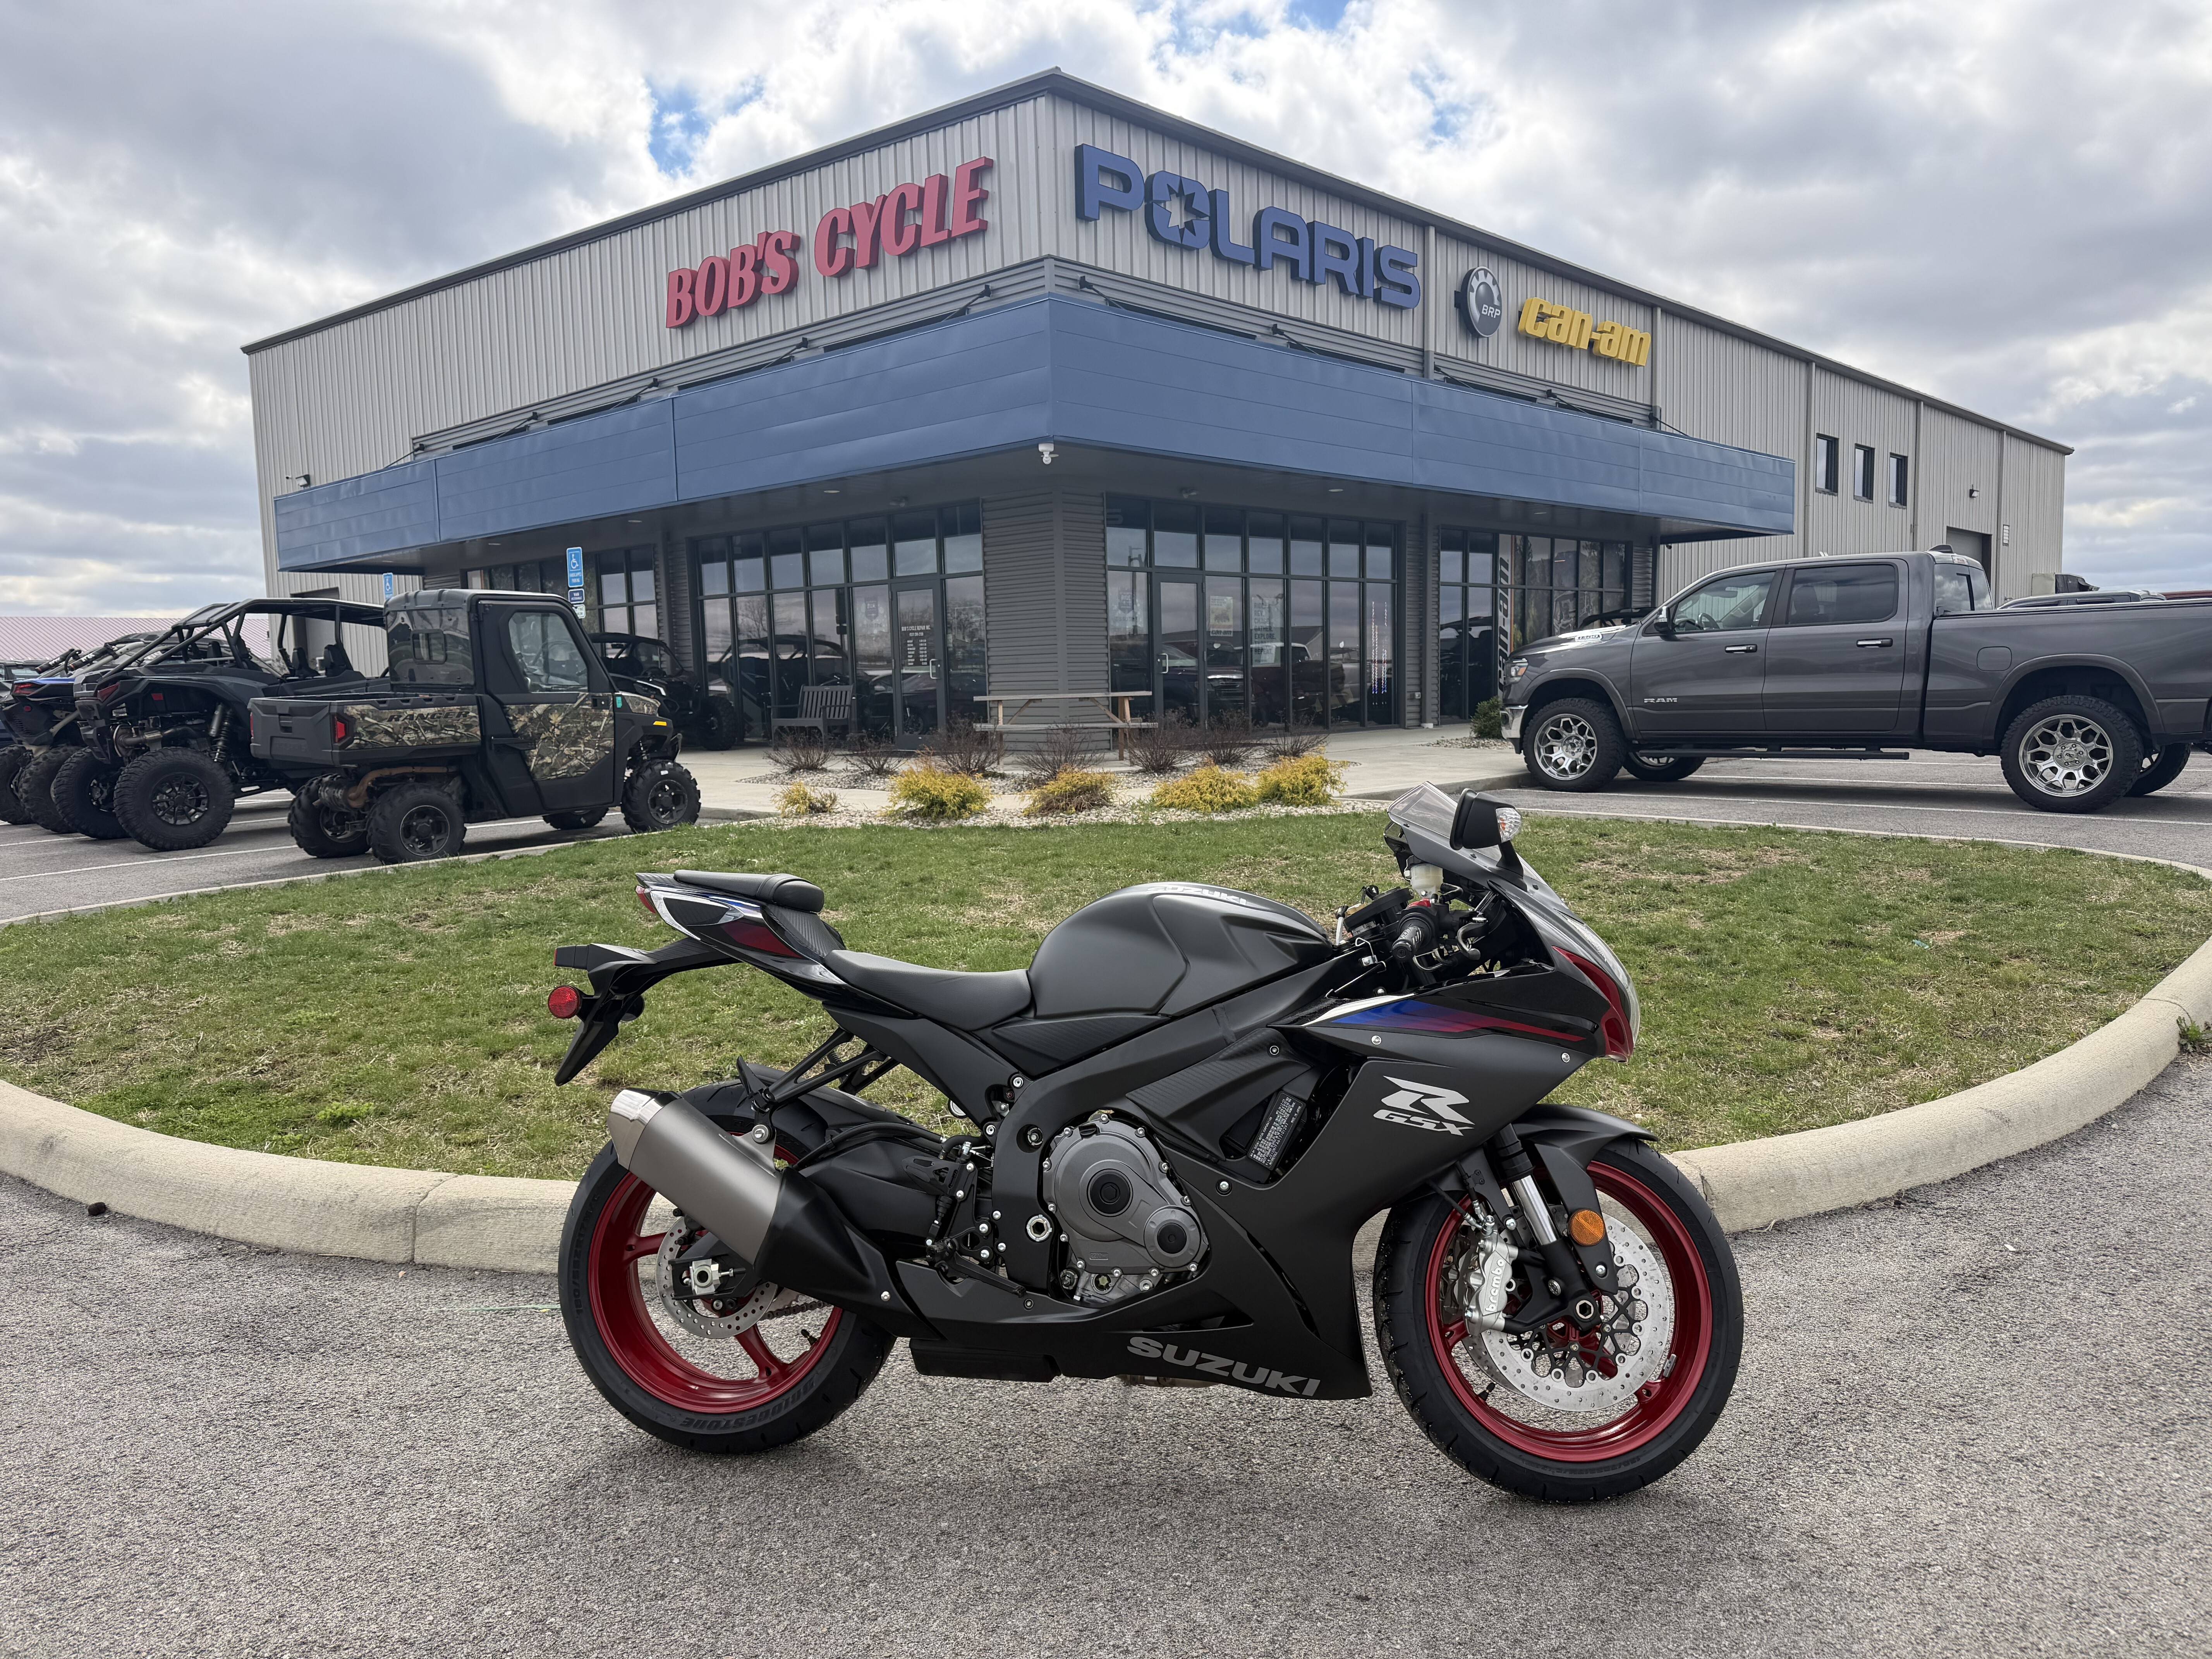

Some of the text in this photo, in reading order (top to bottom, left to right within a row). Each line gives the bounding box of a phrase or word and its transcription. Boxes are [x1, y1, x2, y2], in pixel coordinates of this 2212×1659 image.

[666, 156, 993, 328] BOB'S CYCLE
[1075, 143, 1420, 309] POLARIS
[1482, 304, 1501, 318] BRP
[387, 711, 470, 722] RANGER
[1147, 886, 1246, 905] SUZUKI
[1374, 1109, 1474, 1136] GSX
[1485, 1259, 1504, 1312] brembo
[1127, 1337, 1321, 1396] SUZUKI
[679, 1375, 815, 1431] BRIDGESTONE
